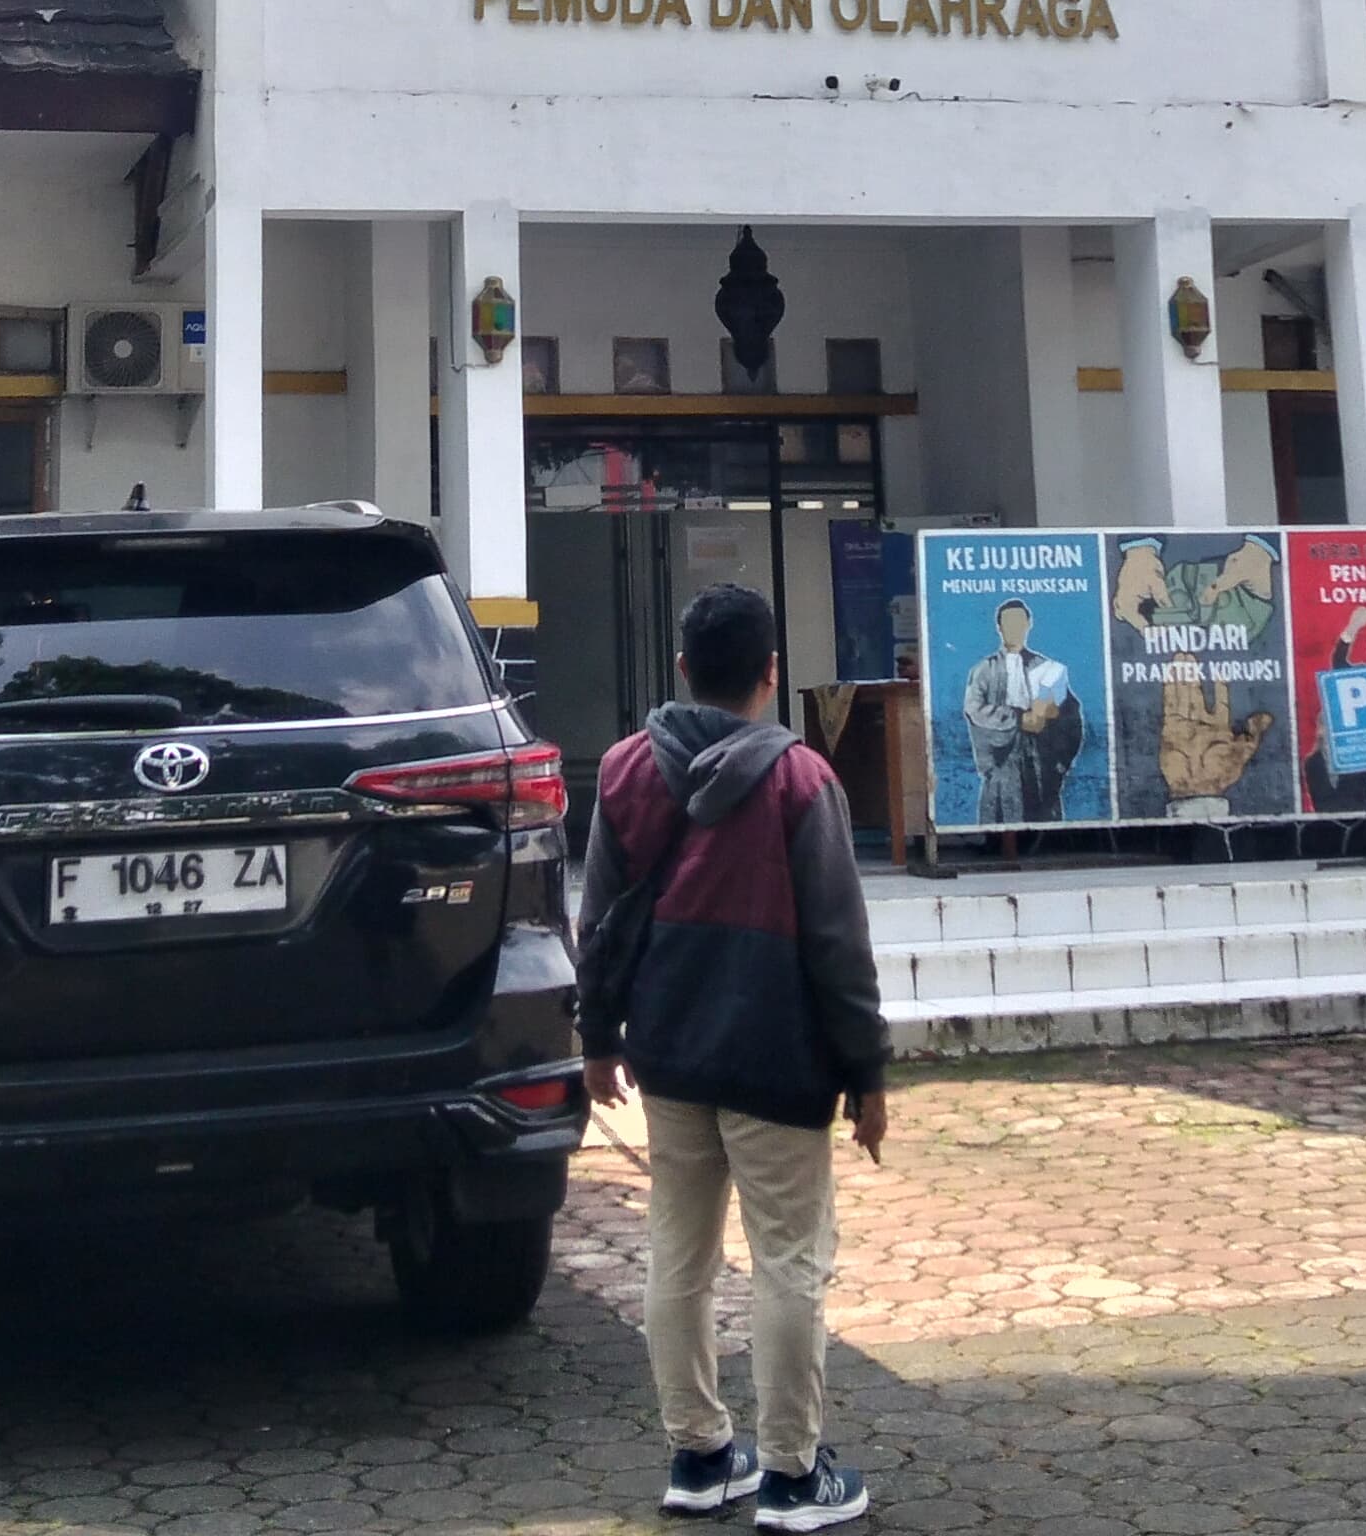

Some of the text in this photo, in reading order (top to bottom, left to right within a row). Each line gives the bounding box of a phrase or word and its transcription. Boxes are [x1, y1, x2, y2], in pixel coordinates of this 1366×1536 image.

[946, 545, 1083, 571] KEJUJURAN
[942, 578, 1088, 594] MENUAI KESUKSESAN
[1144, 623, 1250, 654] HINDARI
[1121, 658, 1282, 683] PRAKTEK KORUPSI
[57, 847, 284, 898] F 1046 ZA
